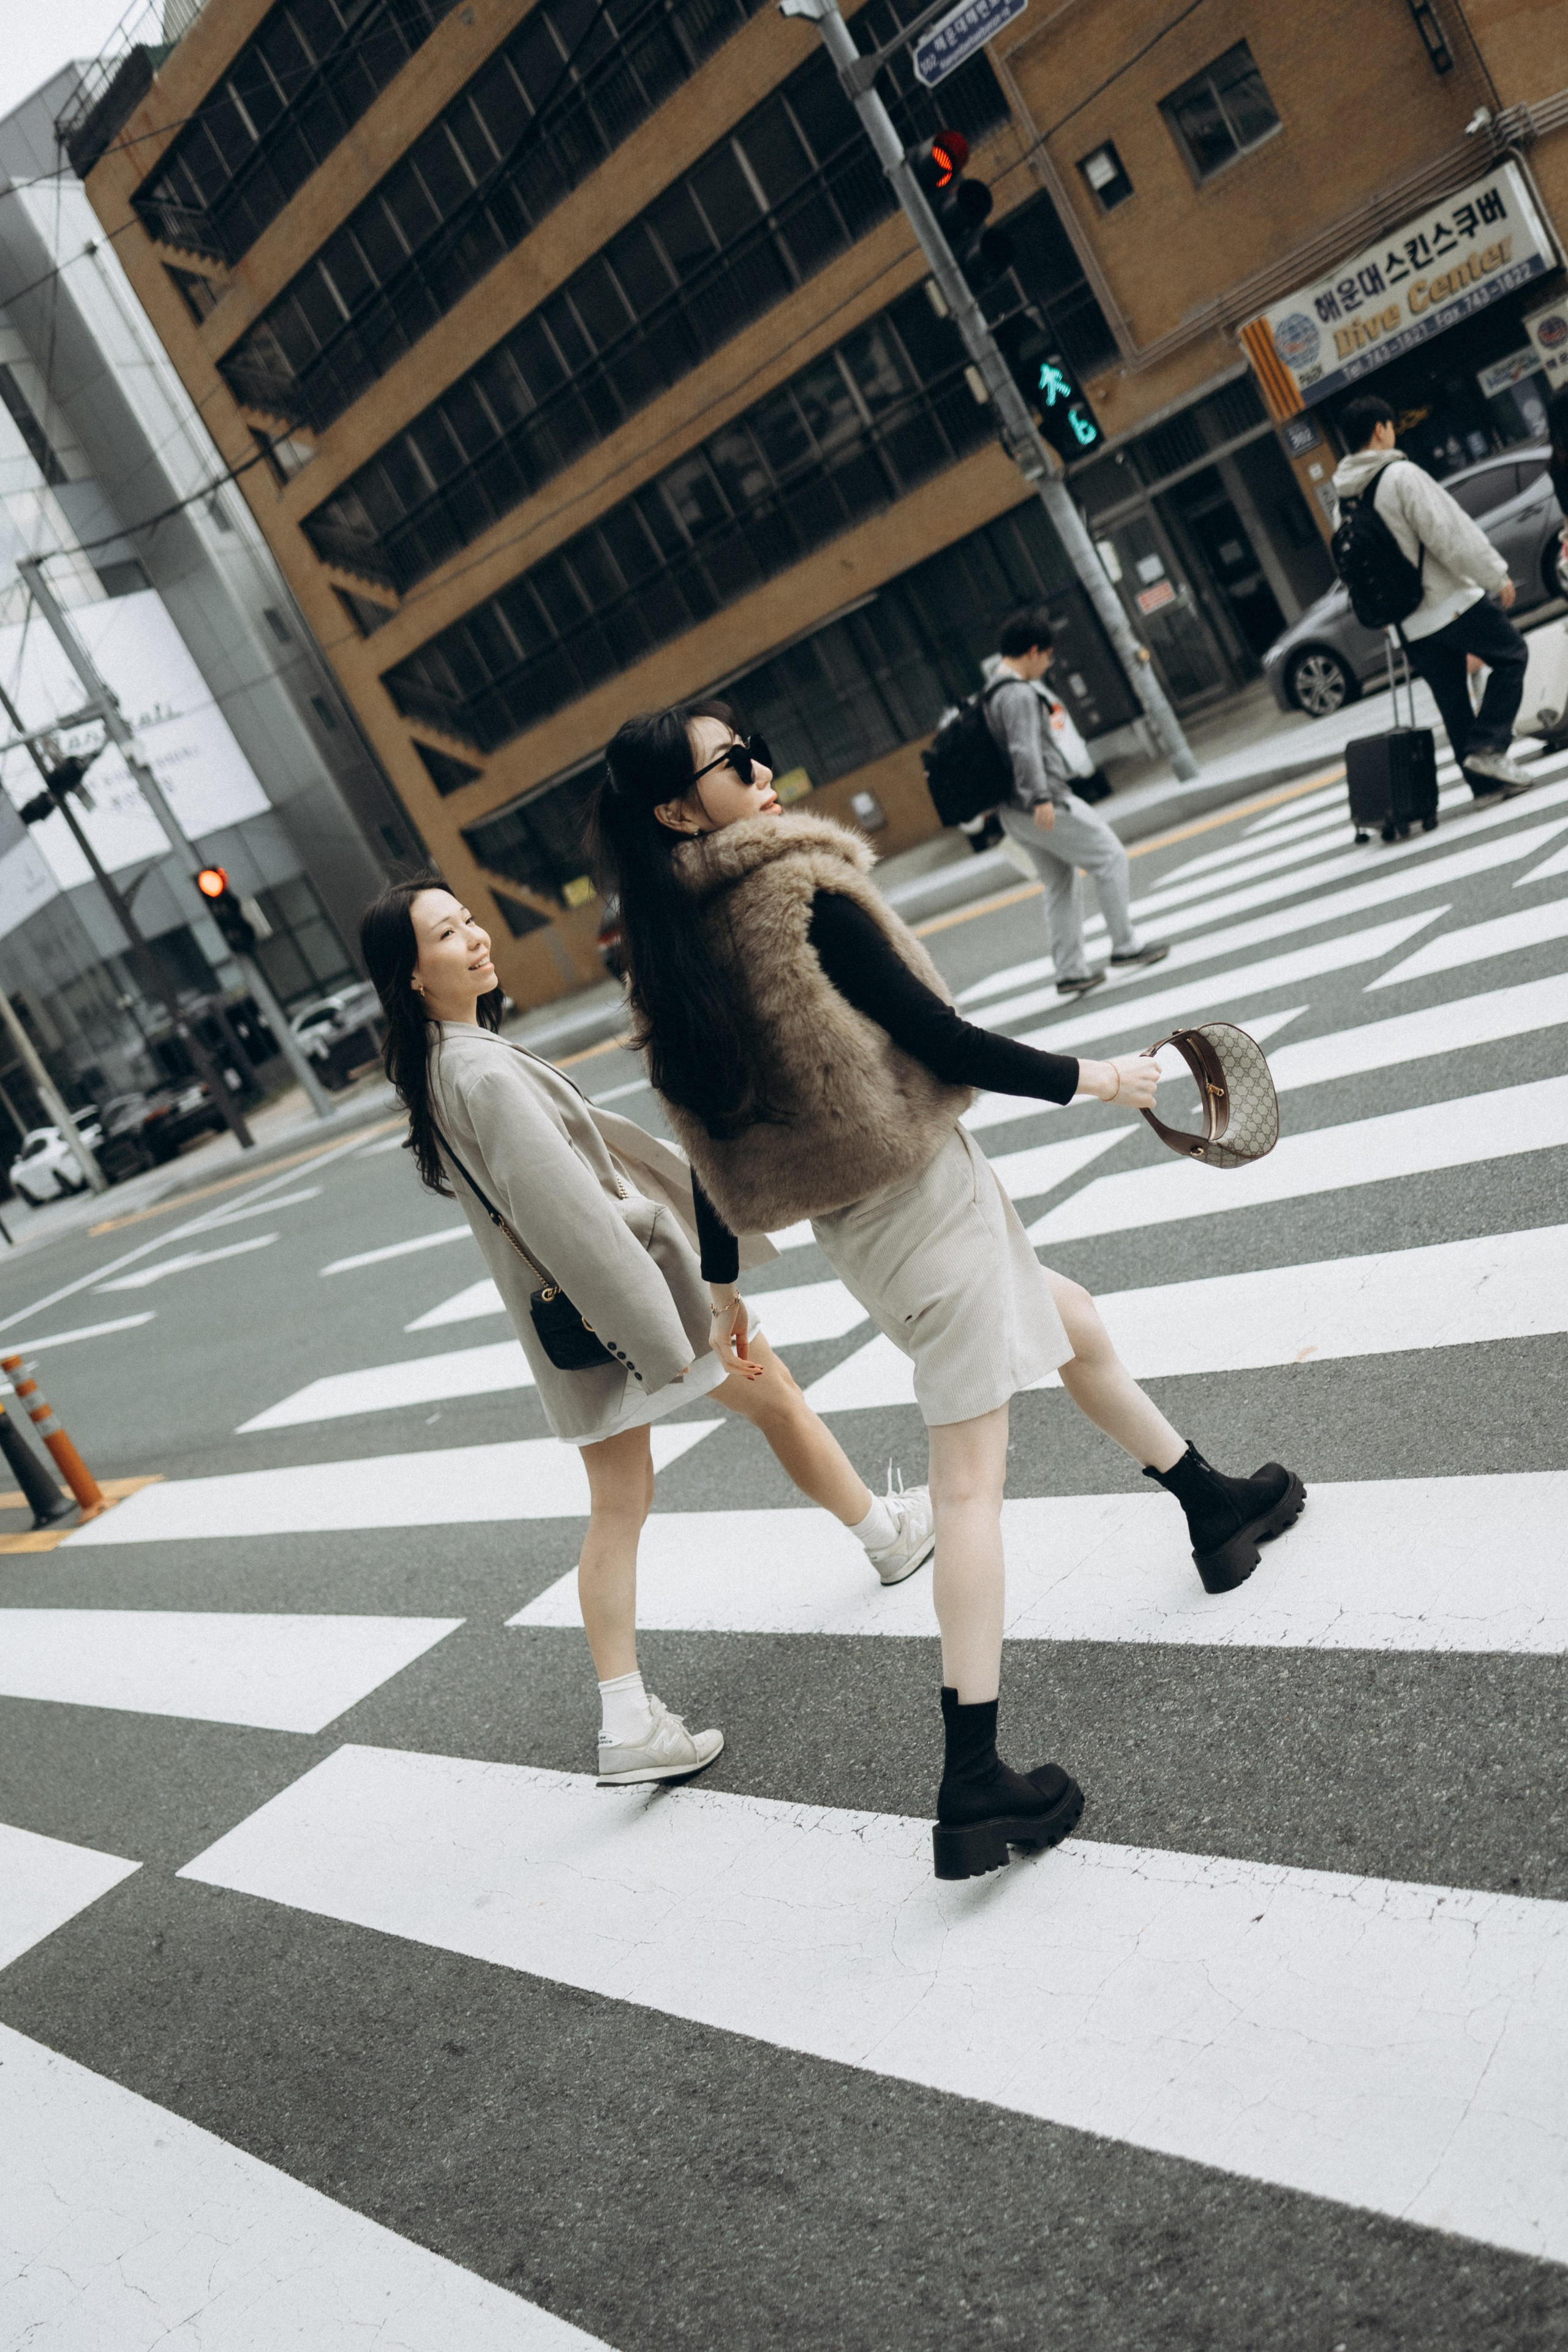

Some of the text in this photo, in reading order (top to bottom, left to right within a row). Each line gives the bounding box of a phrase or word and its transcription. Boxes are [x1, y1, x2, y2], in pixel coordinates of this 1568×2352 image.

[1314, 187, 1508, 322] 해운대스킨스쿠버
[1334, 233, 1513, 360] Dive Center
[1068, 410, 1096, 445] 6
